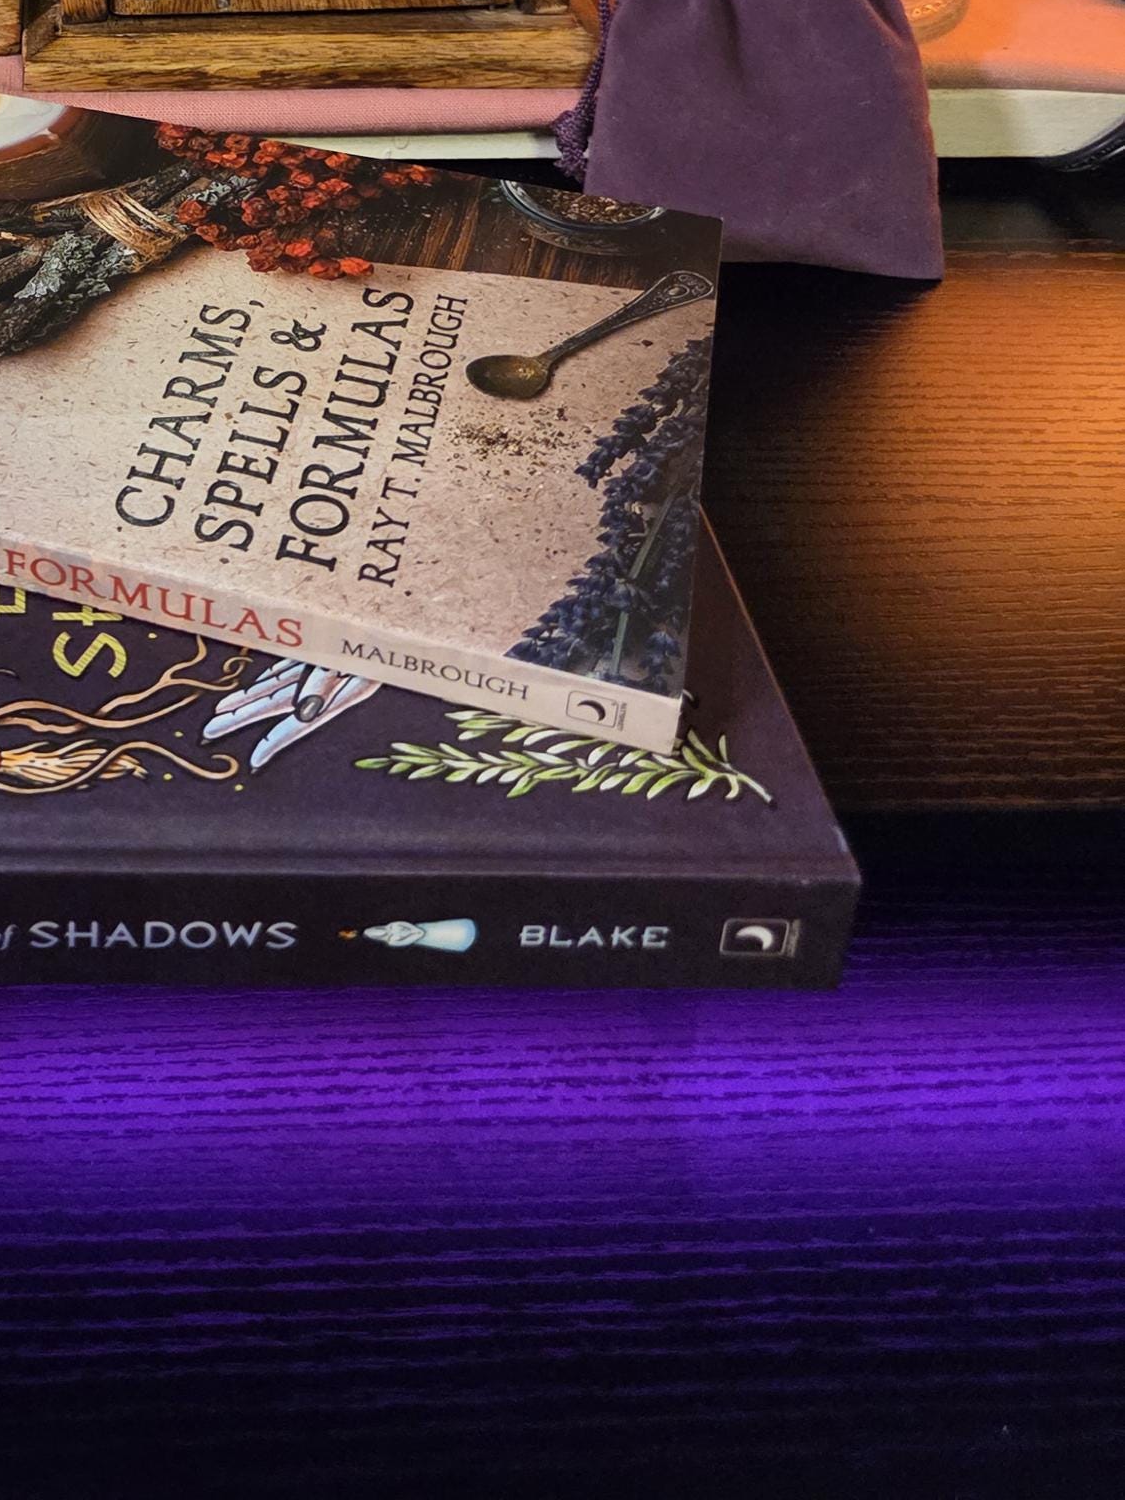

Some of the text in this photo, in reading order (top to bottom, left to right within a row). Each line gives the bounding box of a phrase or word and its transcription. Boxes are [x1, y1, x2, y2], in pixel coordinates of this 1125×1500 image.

[115, 299, 266, 528] CHARMS,
[193, 318, 328, 552] SPELLS &
[275, 287, 415, 572] FORMULAS
[357, 293, 468, 588] RAY T. MALBROUGH
[3, 548, 304, 648] FORMULAS
[340, 638, 530, 701] MALBROUGH
[28, 920, 299, 949] SHADOWS
[518, 924, 671, 948] BLAKE
